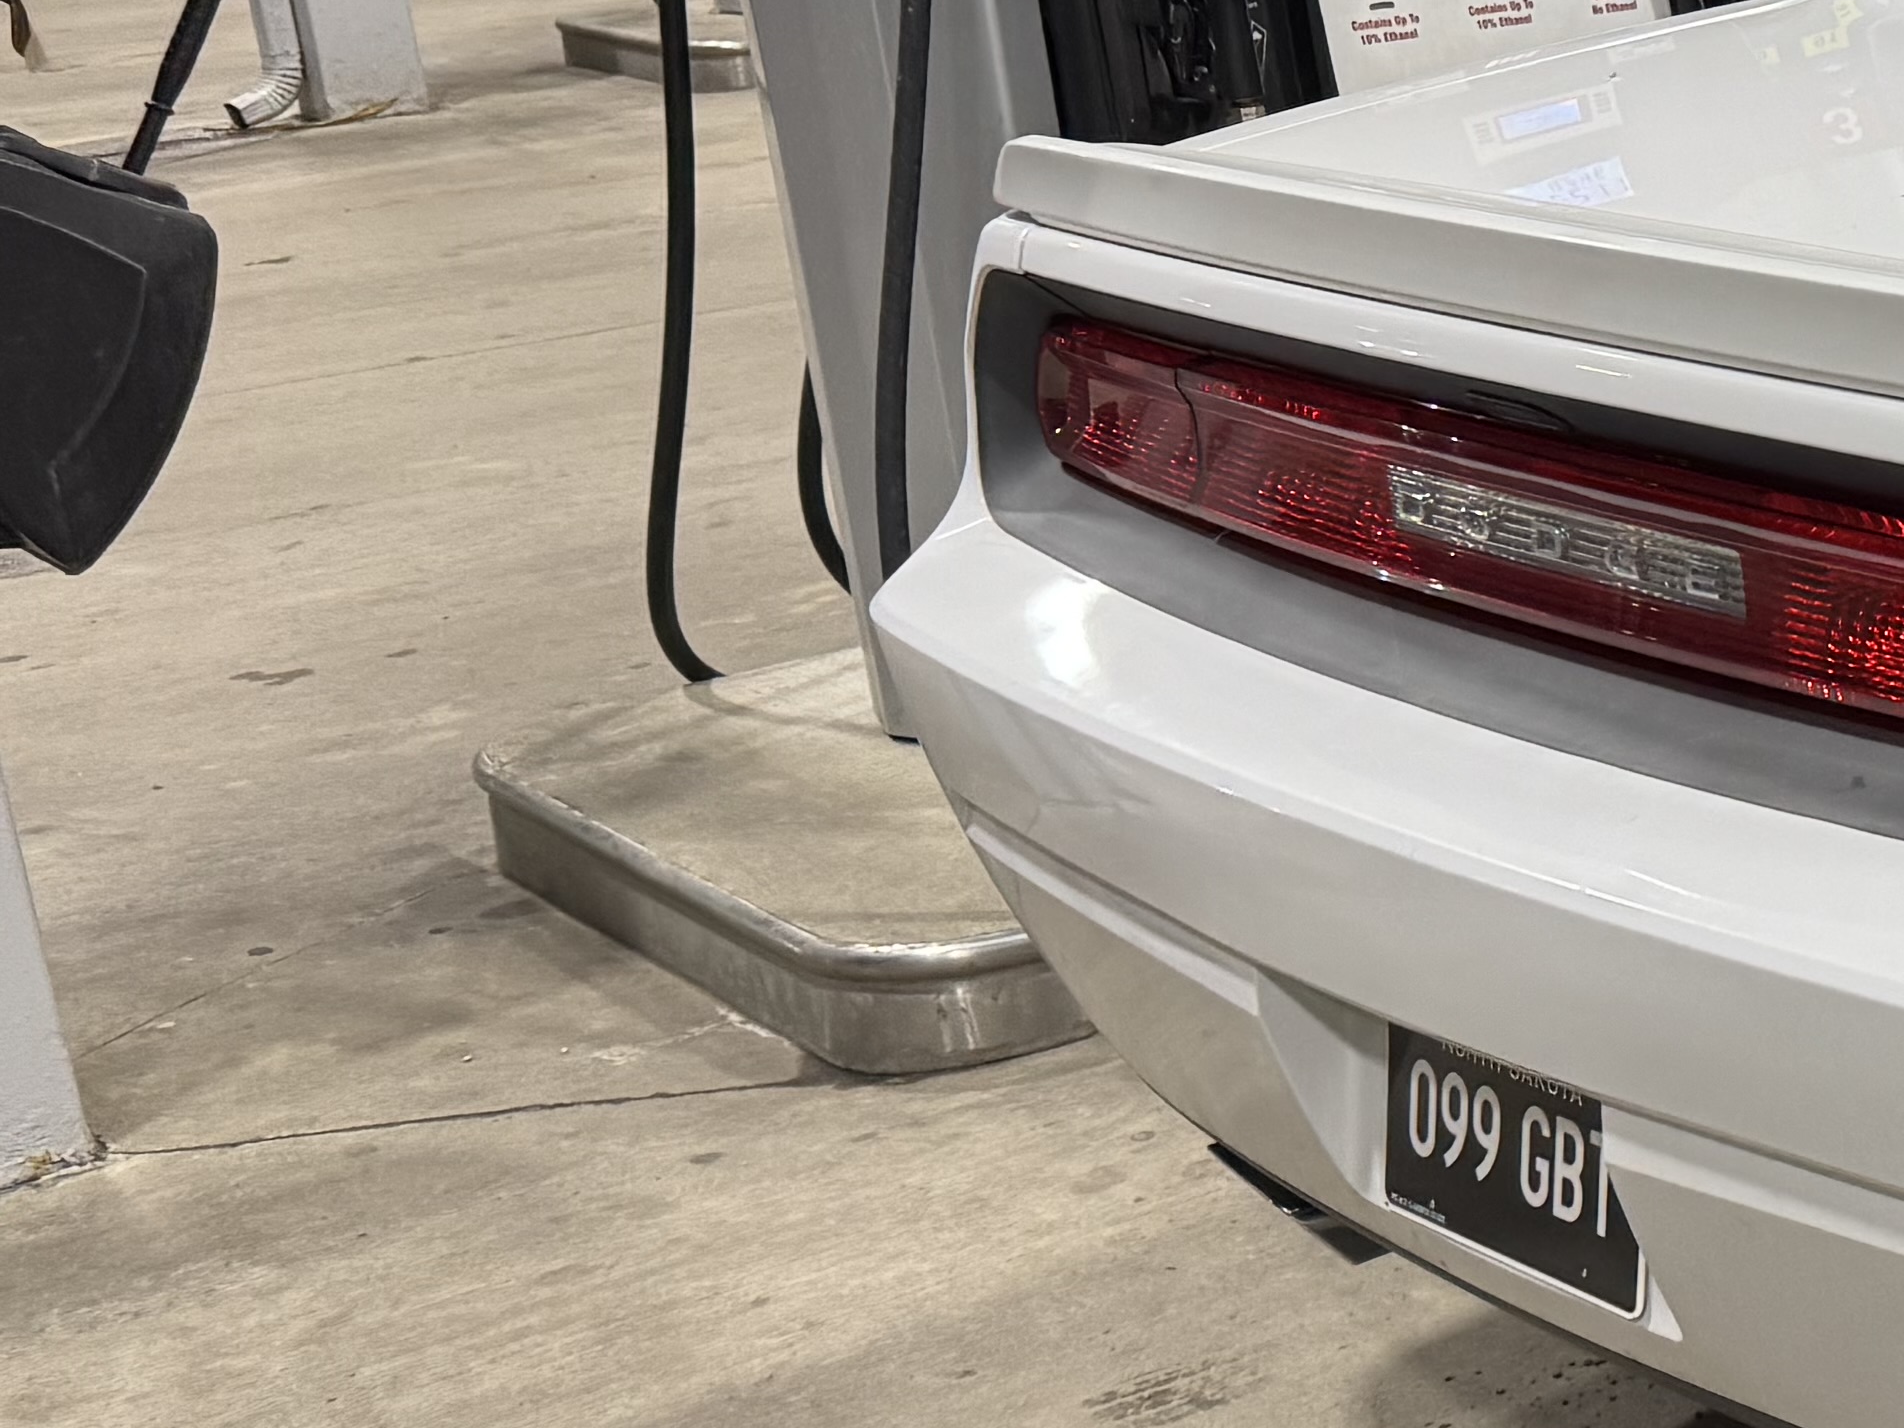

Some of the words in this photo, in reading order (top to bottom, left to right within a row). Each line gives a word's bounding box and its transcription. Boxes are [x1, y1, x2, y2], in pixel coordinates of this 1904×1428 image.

[1468, 3, 1508, 16] Contains
[1509, 1, 1521, 12] Up
[1605, 0, 1637, 13] Ethanol
[1351, 18, 1392, 31] Contains
[1394, 15, 1407, 27] Up
[1409, 13, 1420, 24] To
[1477, 18, 1497, 29] 10%
[1499, 13, 1532, 27] Ethanol
[1361, 33, 1381, 45] 10%
[1383, 28, 1418, 42] Ethanol
[1409, 1059, 1501, 1182] 099
